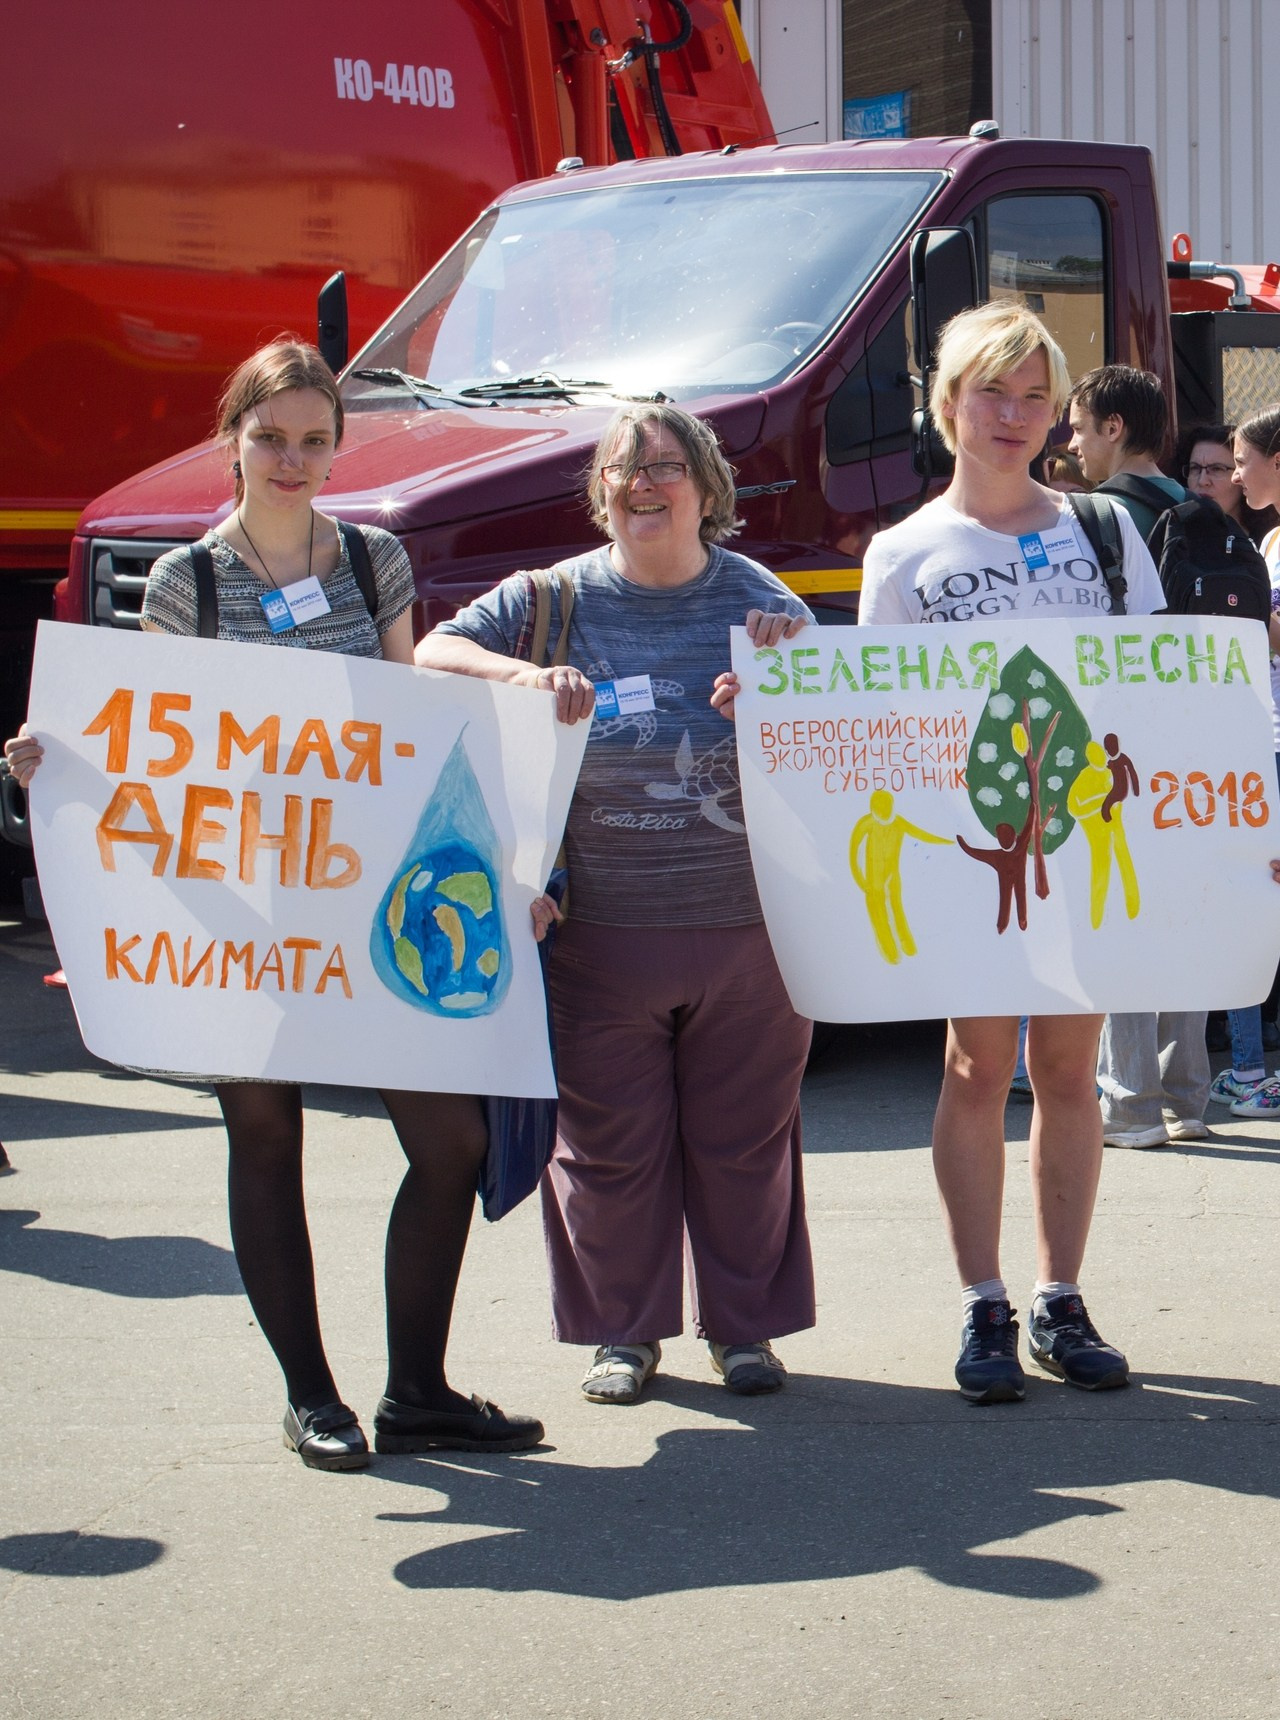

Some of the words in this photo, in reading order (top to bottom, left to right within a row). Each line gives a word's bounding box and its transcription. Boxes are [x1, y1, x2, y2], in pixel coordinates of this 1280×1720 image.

[334, 57, 455, 108] КО-440В
[913, 558, 1106, 610] LONDO
[1032, 586, 1128, 618] ALBIO
[754, 641, 1001, 696] ЗЕЛЕНАЯ
[1075, 634, 1252, 686] ВЕСНА
[618, 689, 649, 699] КОНГРЕСС
[82, 688, 195, 778] 15
[760, 709, 968, 749] ВСЕРОССИЙСКИЙ
[762, 739, 969, 774] ЭКОЛОГИЧЕСКИЙ
[824, 766, 970, 793] СУББОТНИК
[639, 812, 689, 831] Rica
[1150, 771, 1270, 829] 2018
[96, 781, 363, 890] ДЕНЬ
[104, 927, 353, 999] КЛИМАТА
